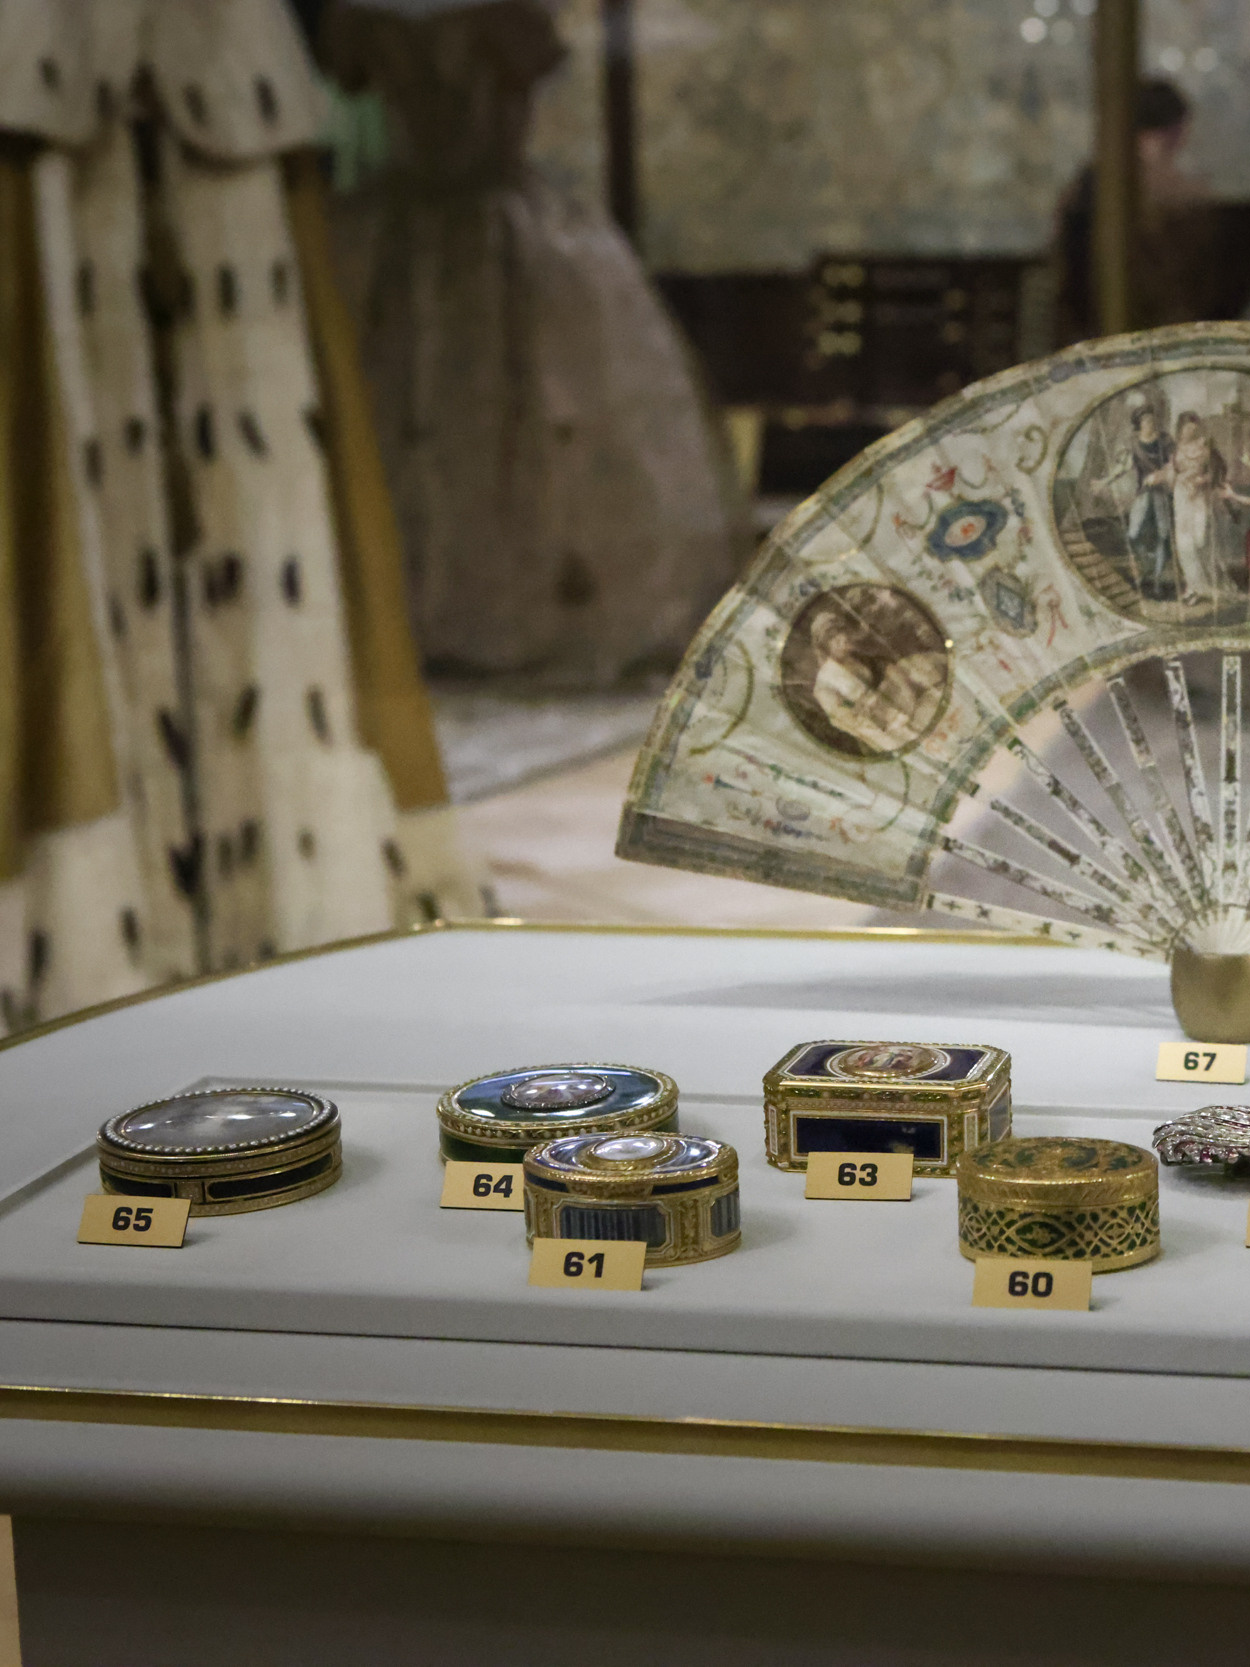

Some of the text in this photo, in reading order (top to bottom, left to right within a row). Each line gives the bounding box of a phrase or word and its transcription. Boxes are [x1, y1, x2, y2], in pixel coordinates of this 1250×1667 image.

[1184, 1051, 1217, 1071] 67
[472, 1173, 514, 1199] 64
[838, 1162, 879, 1187] 63
[111, 1206, 155, 1233] 65
[563, 1251, 605, 1279] 61
[1007, 1270, 1054, 1298] 60
